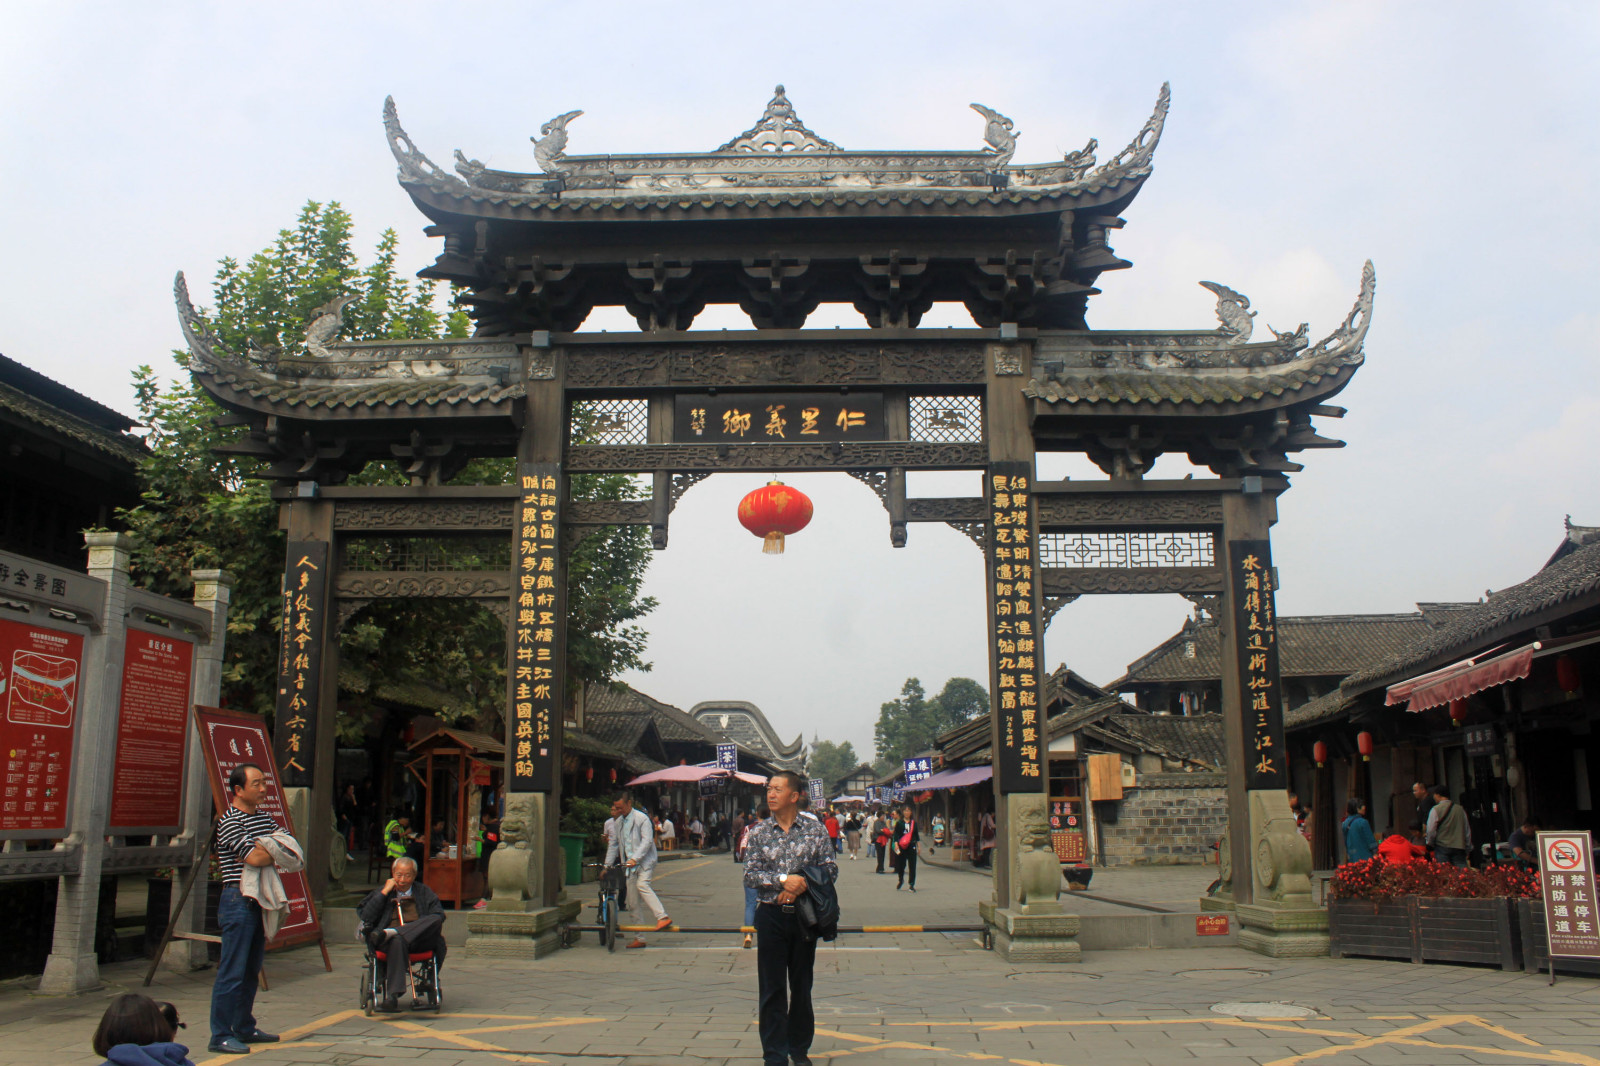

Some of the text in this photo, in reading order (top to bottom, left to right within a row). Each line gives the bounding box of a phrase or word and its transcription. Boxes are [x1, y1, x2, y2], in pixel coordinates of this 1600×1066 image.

[722, 751, 733, 764] 茶
[1550, 874, 1571, 933] 消防通道
[1571, 874, 1592, 933] 禁止停车
